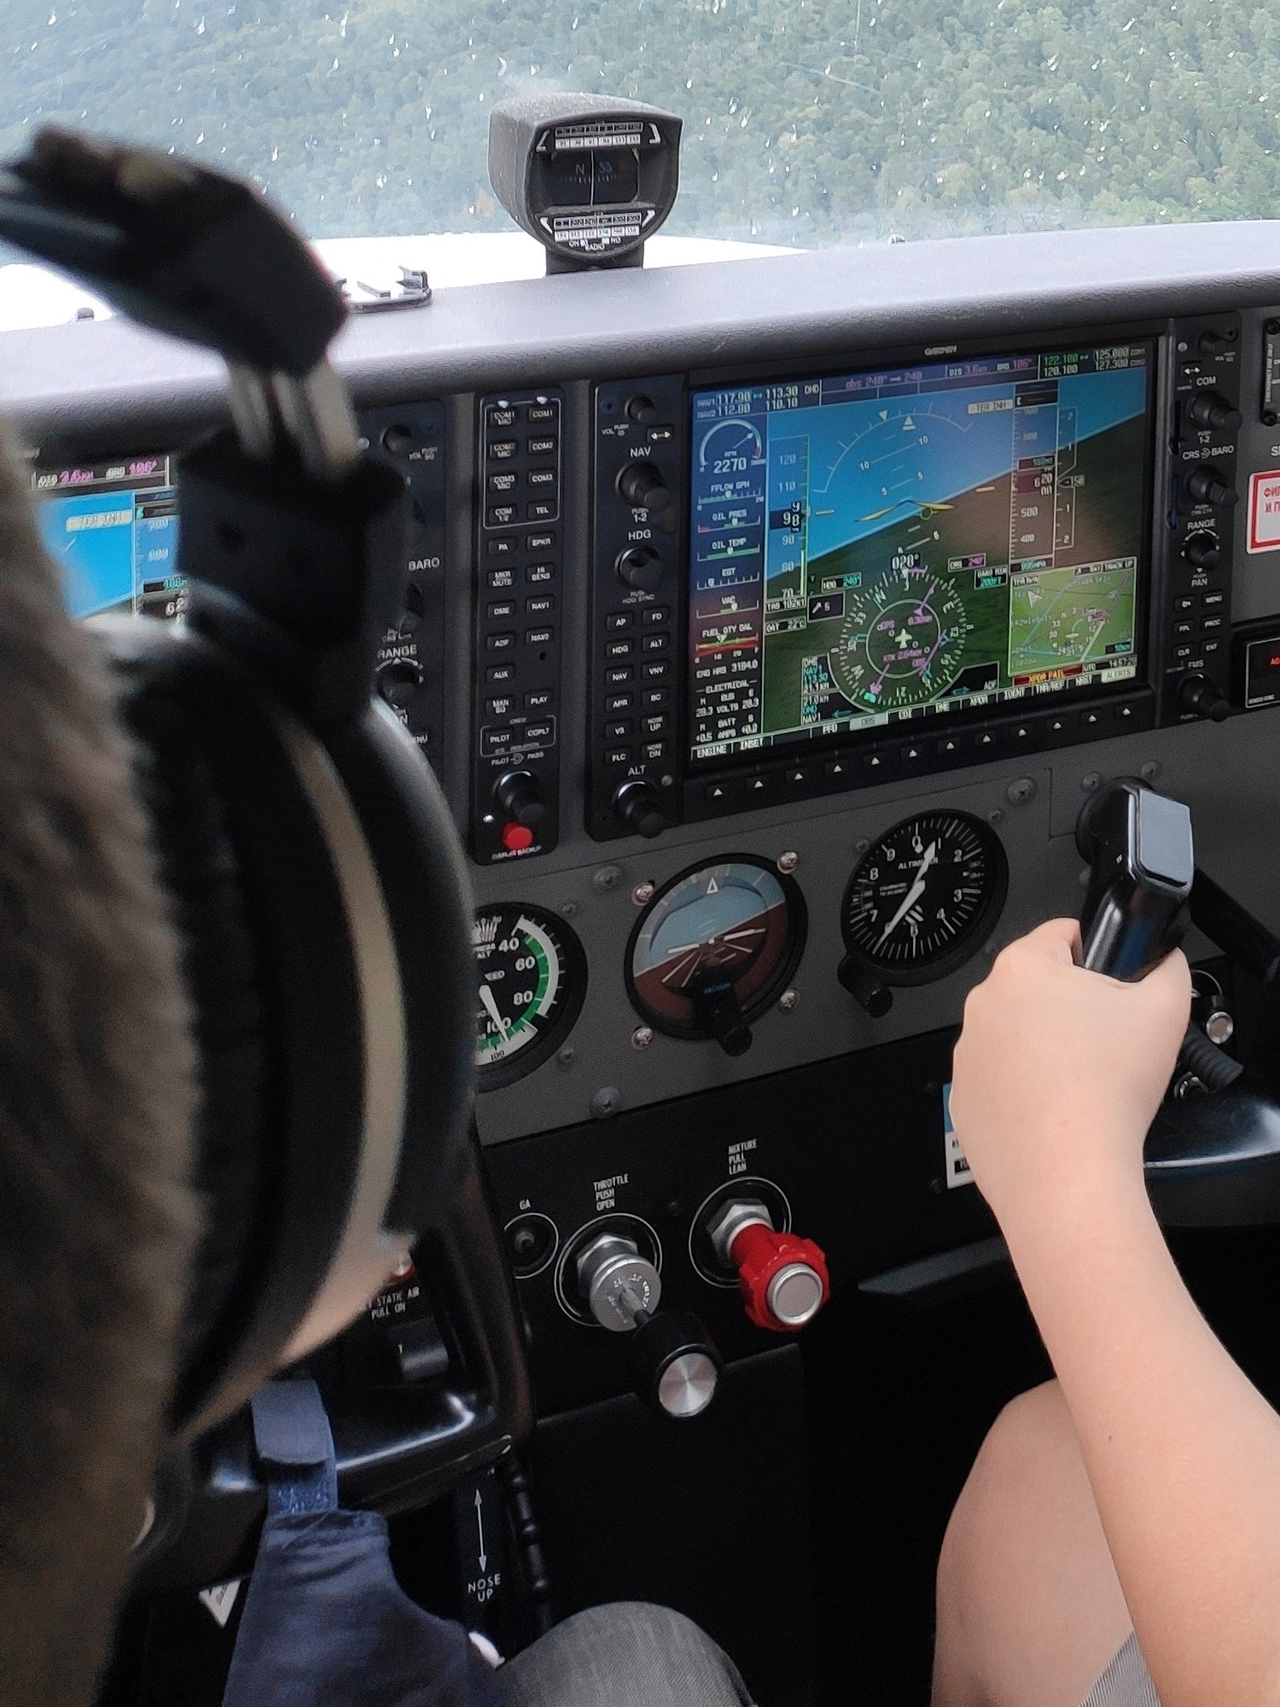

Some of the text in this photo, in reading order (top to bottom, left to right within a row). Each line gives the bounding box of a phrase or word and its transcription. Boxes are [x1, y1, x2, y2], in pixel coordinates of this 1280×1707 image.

[1196, 376, 1216, 386] COM
[533, 409, 553, 417] COM1
[630, 447, 651, 458] NAV
[1183, 446, 1234, 460] CRS BARO
[713, 457, 747, 474] 2270
[532, 474, 553, 482] COM3
[1021, 507, 1038, 517] 500
[1265, 503, 1272, 513] И
[634, 513, 647, 522] 1-2
[1188, 519, 1216, 530] RANGE
[629, 530, 651, 541] HDG
[408, 557, 440, 571] BARO
[1192, 578, 1208, 587] PAN
[532, 602, 549, 610] NAV1
[652, 612, 662, 621] FD
[616, 618, 627, 627] AP
[650, 639, 662, 648] ALT
[378, 644, 417, 659] RANGE
[612, 645, 628, 654] HDG
[494, 670, 509, 679] AUX
[612, 672, 627, 680] NAV
[649, 666, 663, 675] VNV
[1106, 669, 1131, 679] ALERTS
[531, 696, 547, 704] PLAY
[528, 727, 550, 737] COPLT
[650, 723, 661, 731] UP
[490, 734, 510, 743] PILOT
[649, 750, 660, 758] DN
[697, 745, 727, 758] ENGINE
[612, 753, 626, 762] FLC
[628, 765, 646, 775] ALT
[887, 849, 895, 861] 9
[954, 850, 963, 862] 2
[898, 857, 939, 869] ALTIMER
[870, 868, 878, 880] 8
[954, 889, 962, 902] 3
[870, 910, 878, 922] 7
[937, 908, 945, 919] 4
[498, 937, 520, 952] 40
[515, 956, 535, 972] 60
[513, 990, 533, 1006] 80
[728, 1139, 757, 1154] MIXTURE
[728, 1153, 745, 1165] PULL
[729, 1162, 747, 1175] LEAN
[593, 1174, 629, 1191] THROTTLE
[596, 1189, 615, 1201] PUSH
[519, 1199, 531, 1210] GA
[596, 1199, 615, 1211] OPEN
[406, 1286, 420, 1299] AIR
[371, 1302, 406, 1320] PULL ON
[468, 1574, 501, 1594] NOSE
[478, 1588, 494, 1602] UP
